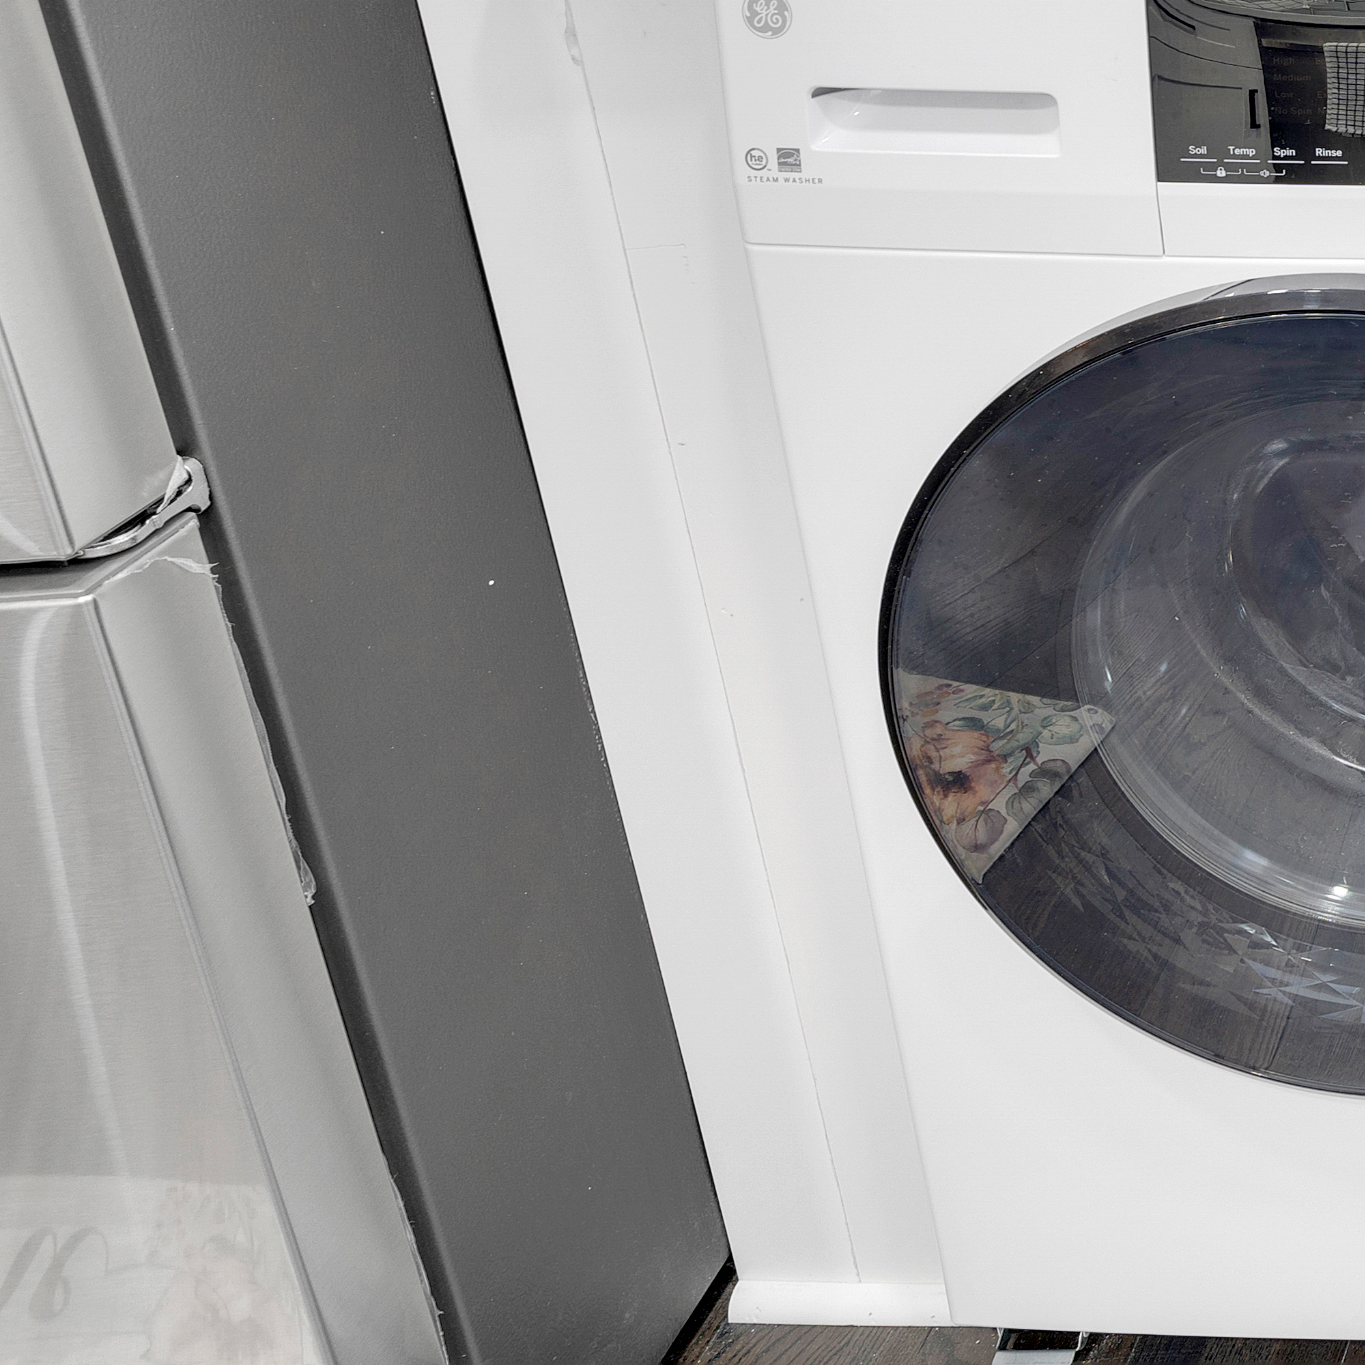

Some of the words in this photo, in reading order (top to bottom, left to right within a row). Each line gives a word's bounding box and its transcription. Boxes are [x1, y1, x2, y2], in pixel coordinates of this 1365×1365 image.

[1273, 57, 1294, 65] High
[1189, 145, 1207, 155] Soil
[1228, 146, 1256, 156] Temp
[1274, 147, 1296, 157] Spin
[1315, 147, 1342, 157] Rinse
